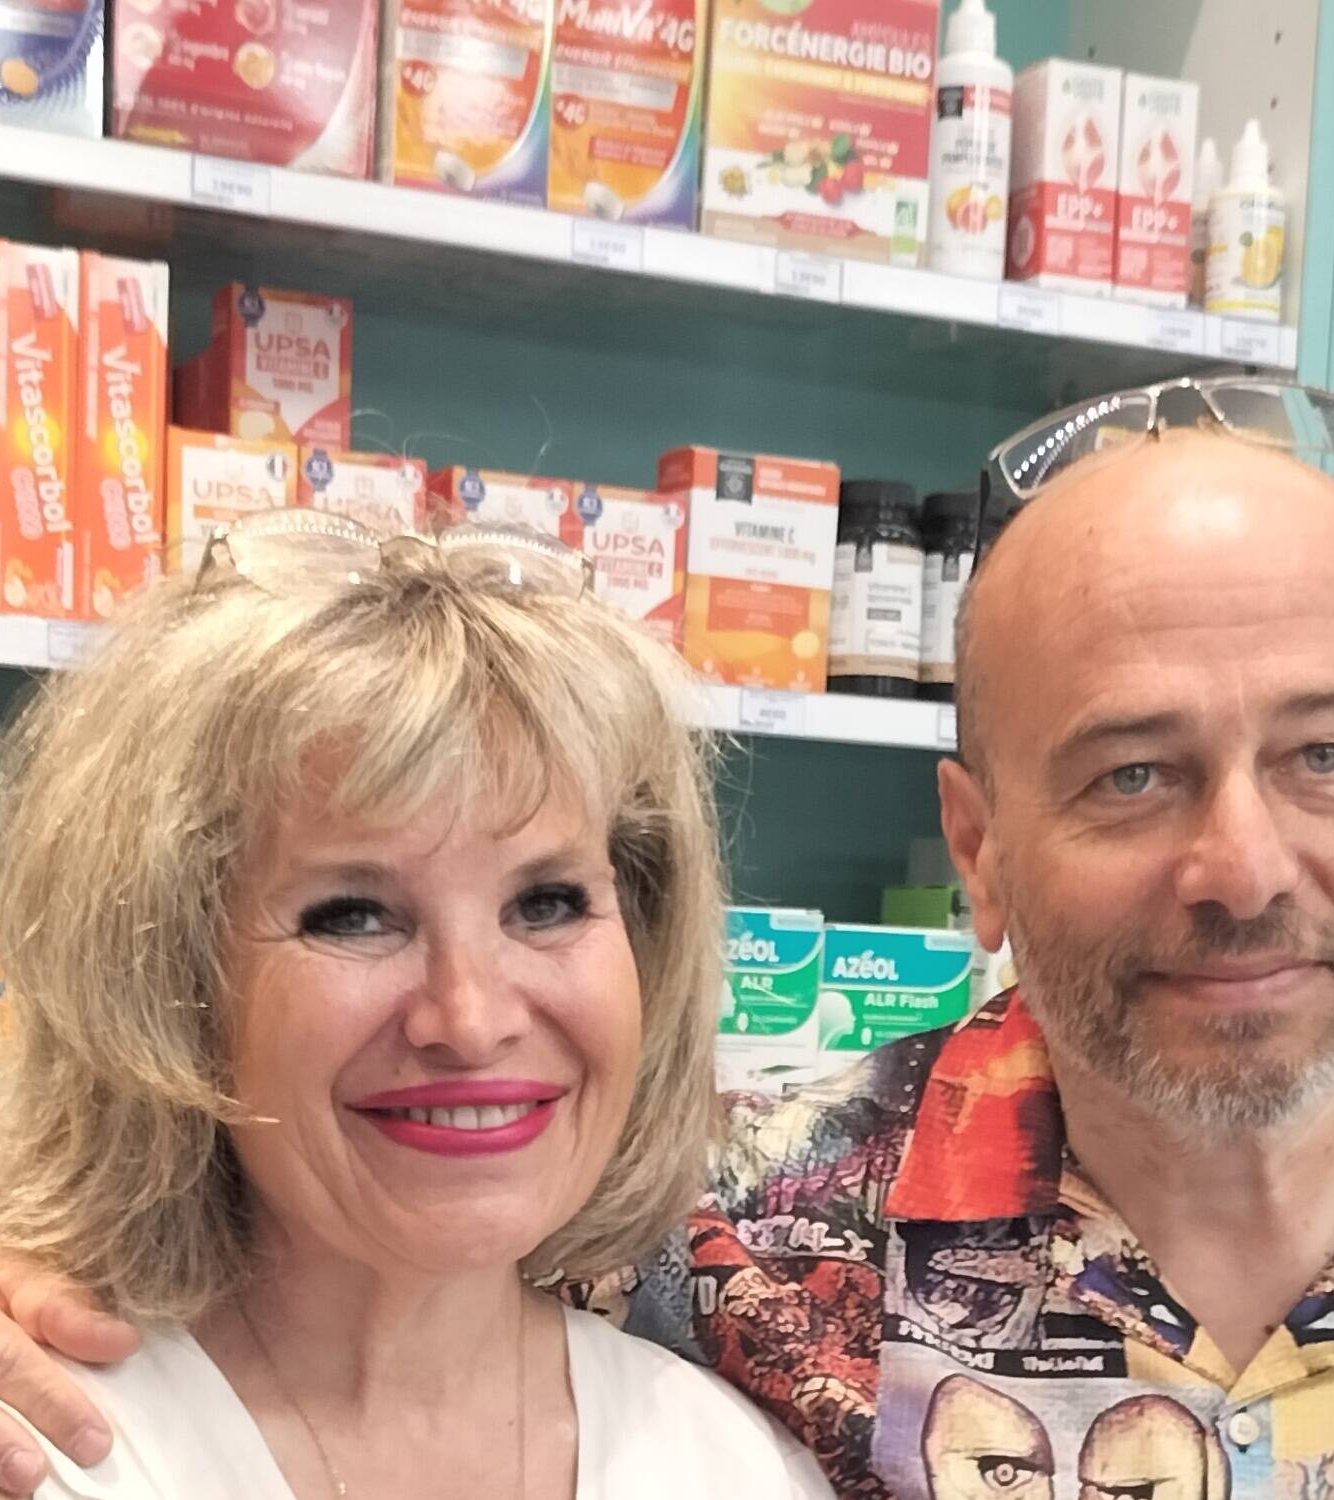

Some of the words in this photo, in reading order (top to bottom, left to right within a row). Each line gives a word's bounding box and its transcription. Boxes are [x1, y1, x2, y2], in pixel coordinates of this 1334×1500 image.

[889, 45, 932, 80] BIO
[254, 332, 331, 361] UPSA
[10, 331, 73, 533] Vitascorbol
[102, 343, 162, 545] Vitascorbol
[592, 531, 665, 558] UPSA
